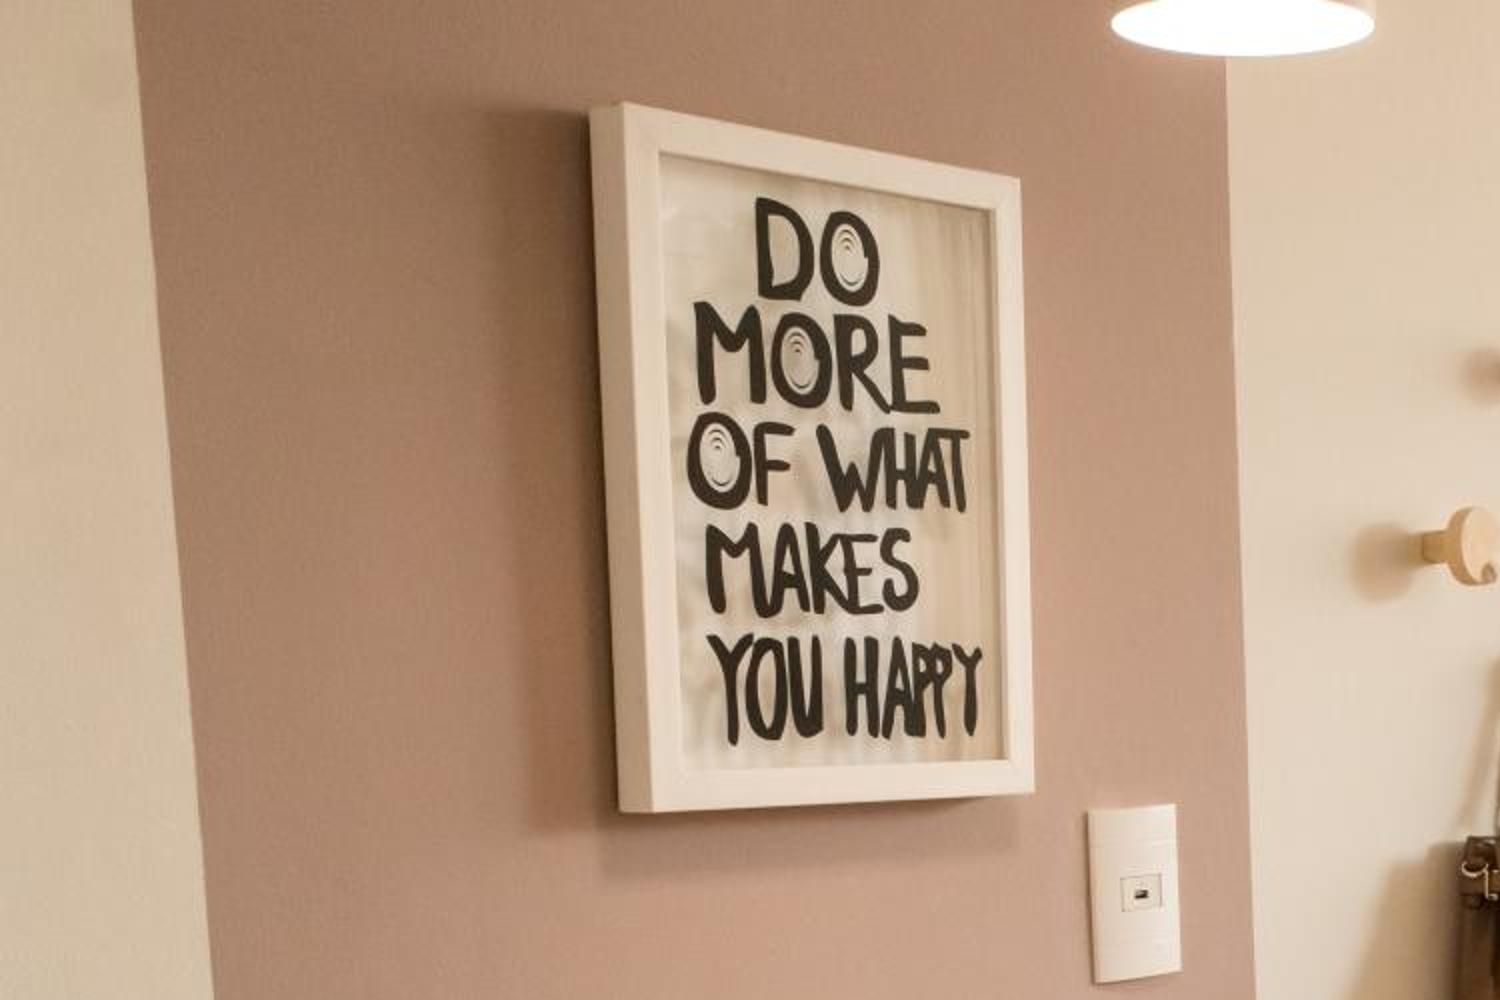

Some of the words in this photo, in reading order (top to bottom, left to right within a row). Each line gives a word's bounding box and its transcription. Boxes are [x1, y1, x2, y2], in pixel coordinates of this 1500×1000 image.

[755, 197, 880, 307] DO
[692, 301, 941, 414] MORE
[686, 411, 795, 510] OF
[815, 424, 970, 513] WHAT
[705, 521, 919, 619] MAKES
[706, 633, 824, 746] YOU
[844, 635, 983, 740] HAPPY
